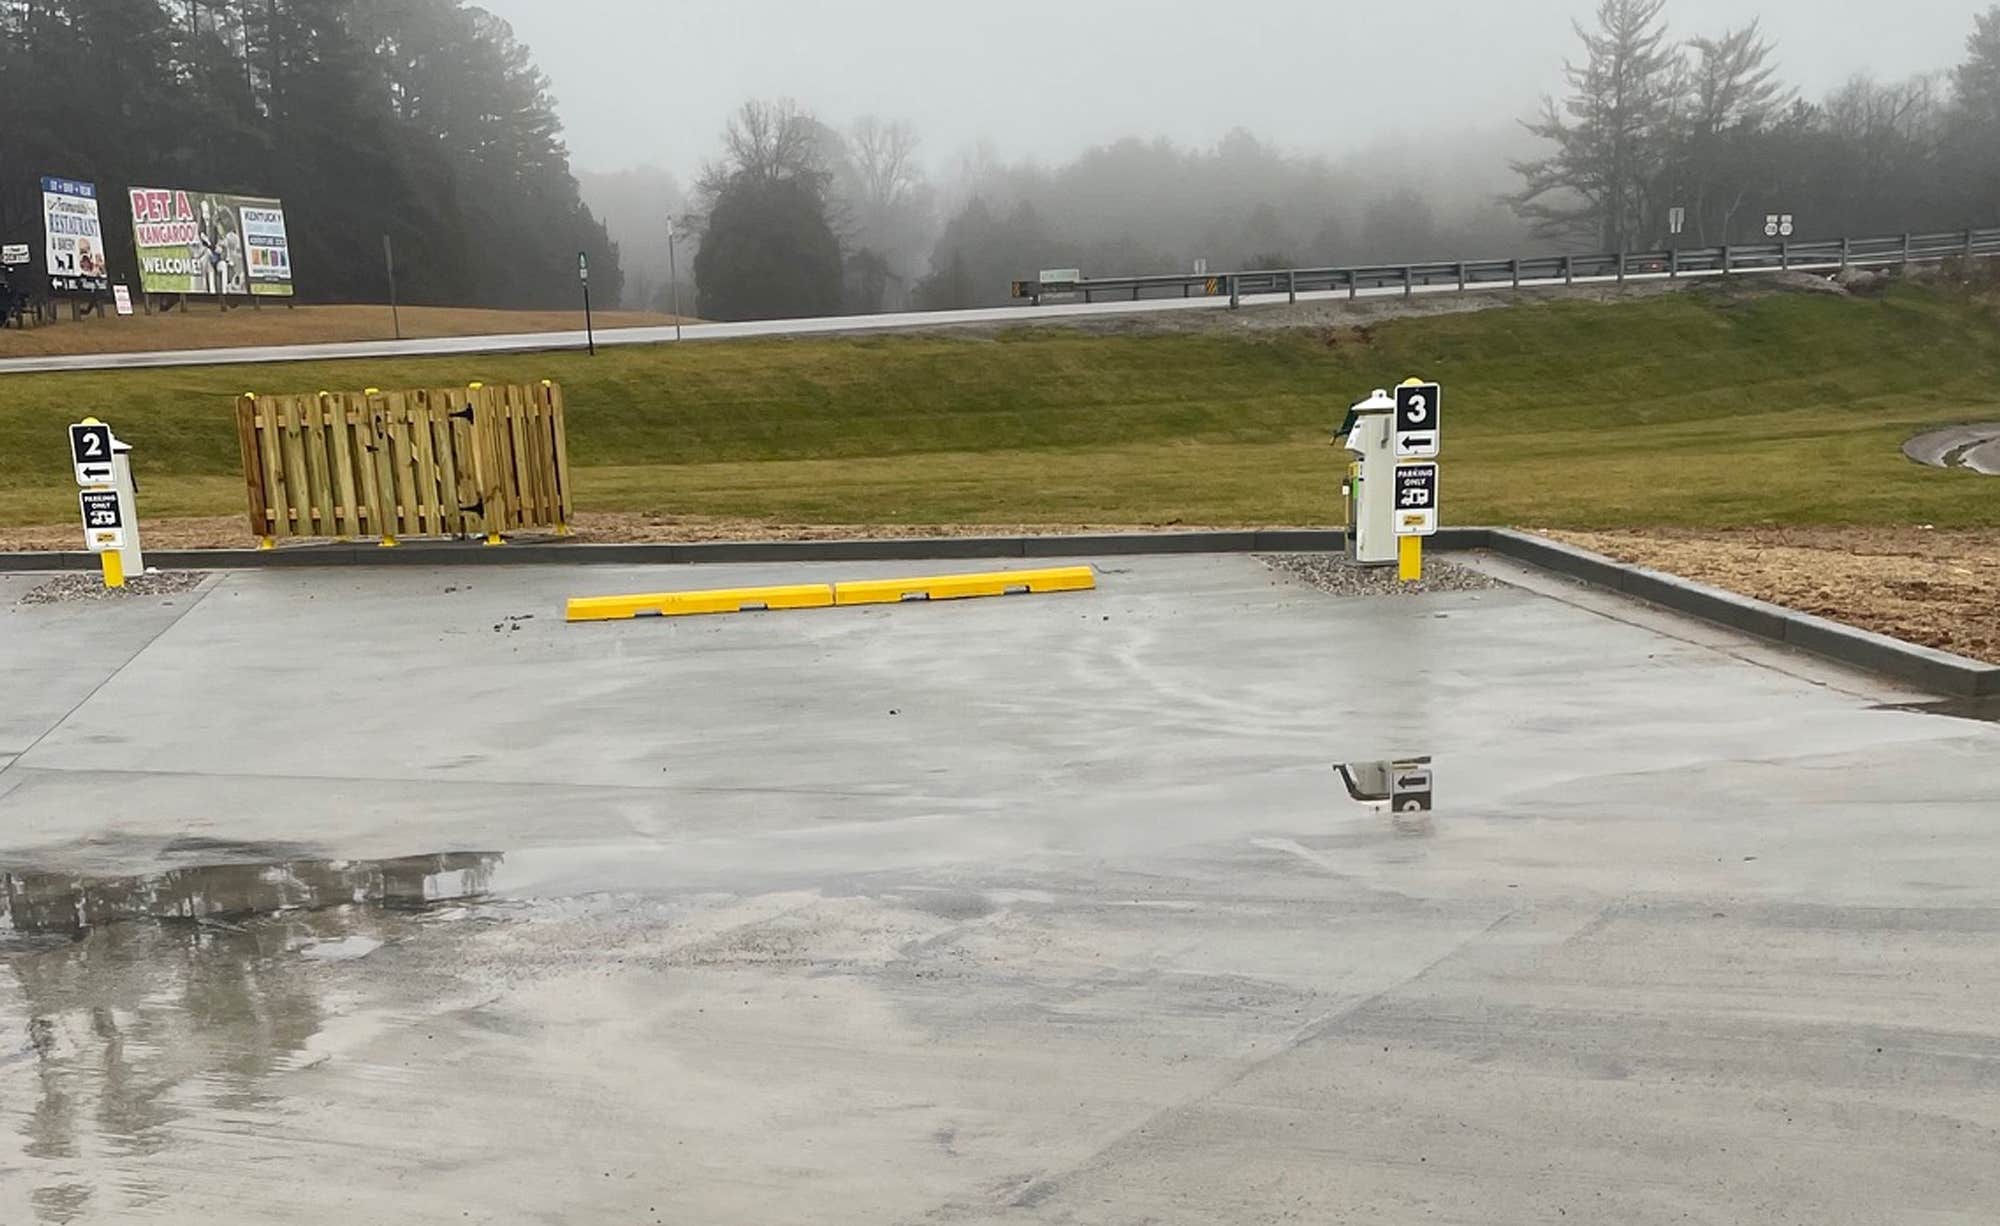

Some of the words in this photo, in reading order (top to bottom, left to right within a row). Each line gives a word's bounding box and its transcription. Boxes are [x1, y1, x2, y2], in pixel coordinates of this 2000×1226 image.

[132, 191, 170, 220] PET
[177, 191, 193, 220] A
[1407, 394, 1427, 423] 3
[82, 432, 102, 456] 2
[1397, 469, 1433, 478] PARKING
[1404, 478, 1426, 486] ONLY
